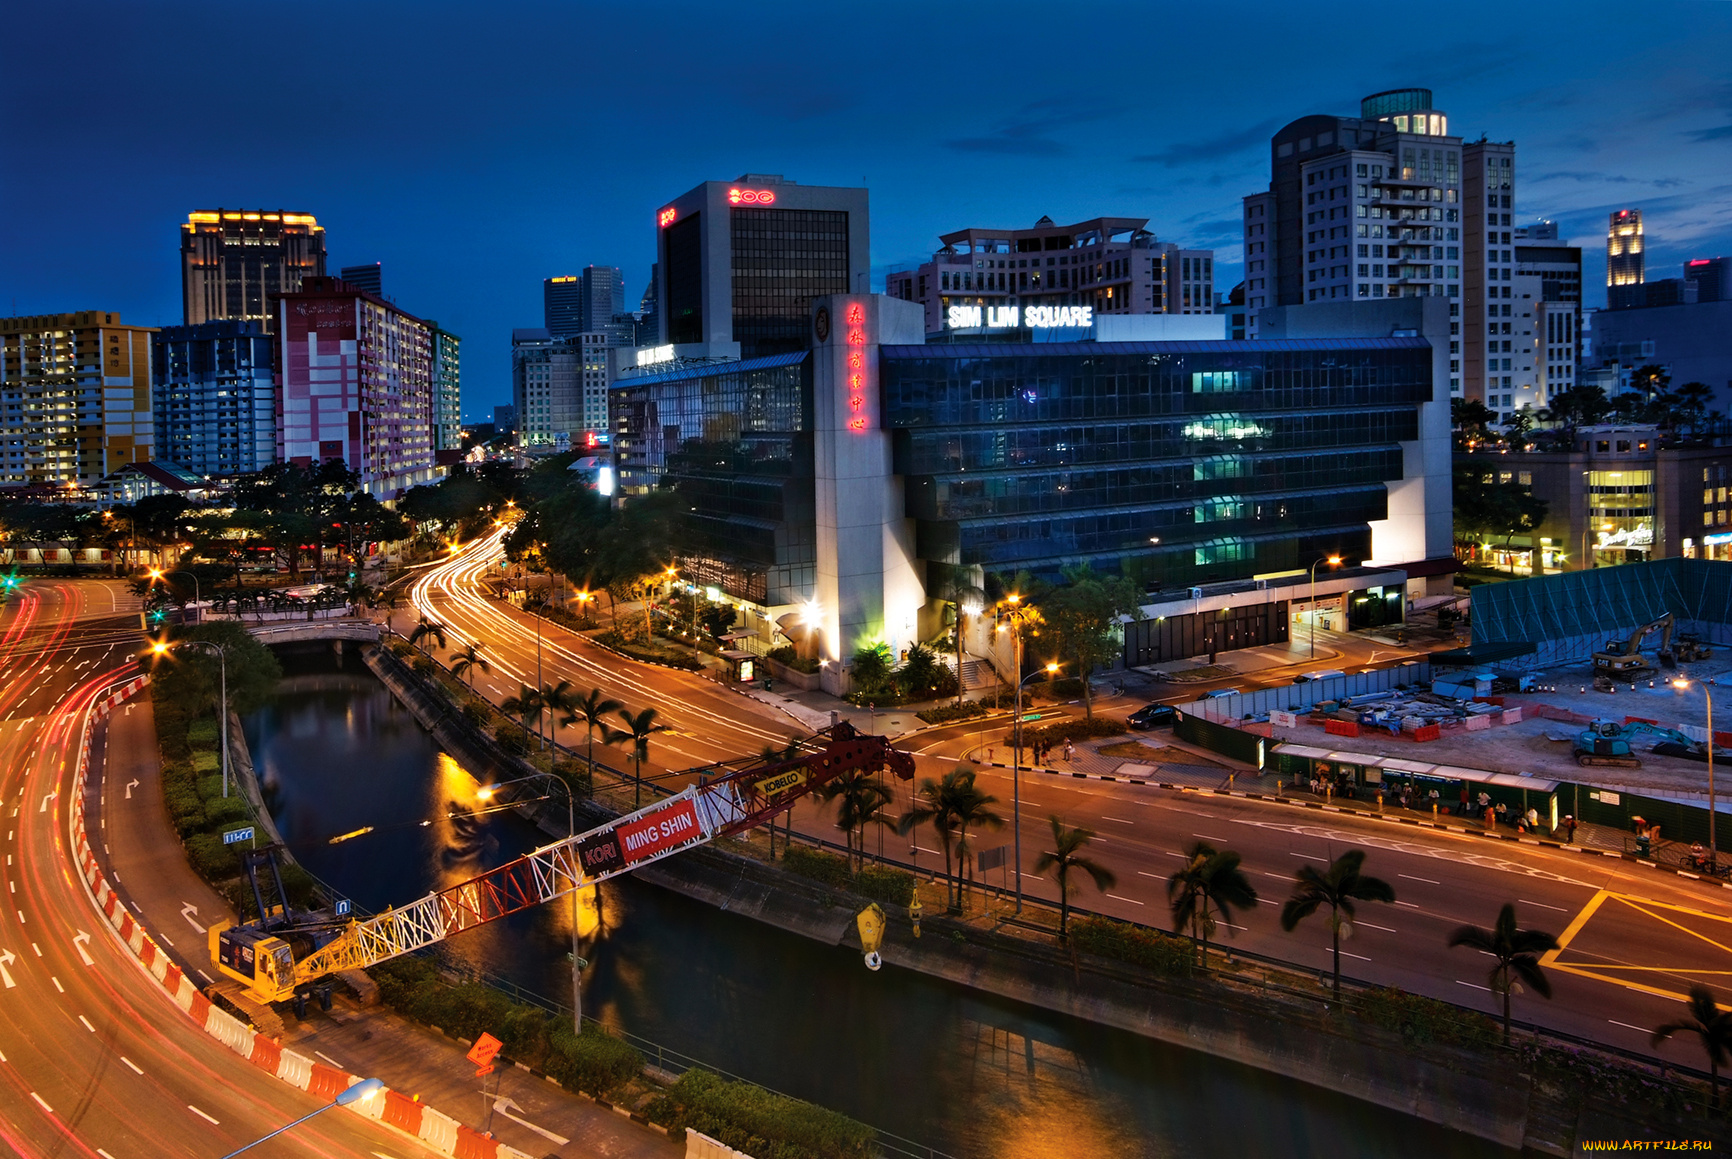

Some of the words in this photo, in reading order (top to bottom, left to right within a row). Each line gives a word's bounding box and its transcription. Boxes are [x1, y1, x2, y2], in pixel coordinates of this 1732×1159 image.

[948, 305, 982, 328] SIM
[987, 305, 1019, 328] LIM
[1025, 305, 1093, 328] SQUARE
[1597, 659, 1609, 667] CAT
[764, 773, 798, 793] KOBELCO
[584, 842, 617, 866] KORI
[625, 826, 659, 852] MING
[660, 812, 693, 837] SHIN
